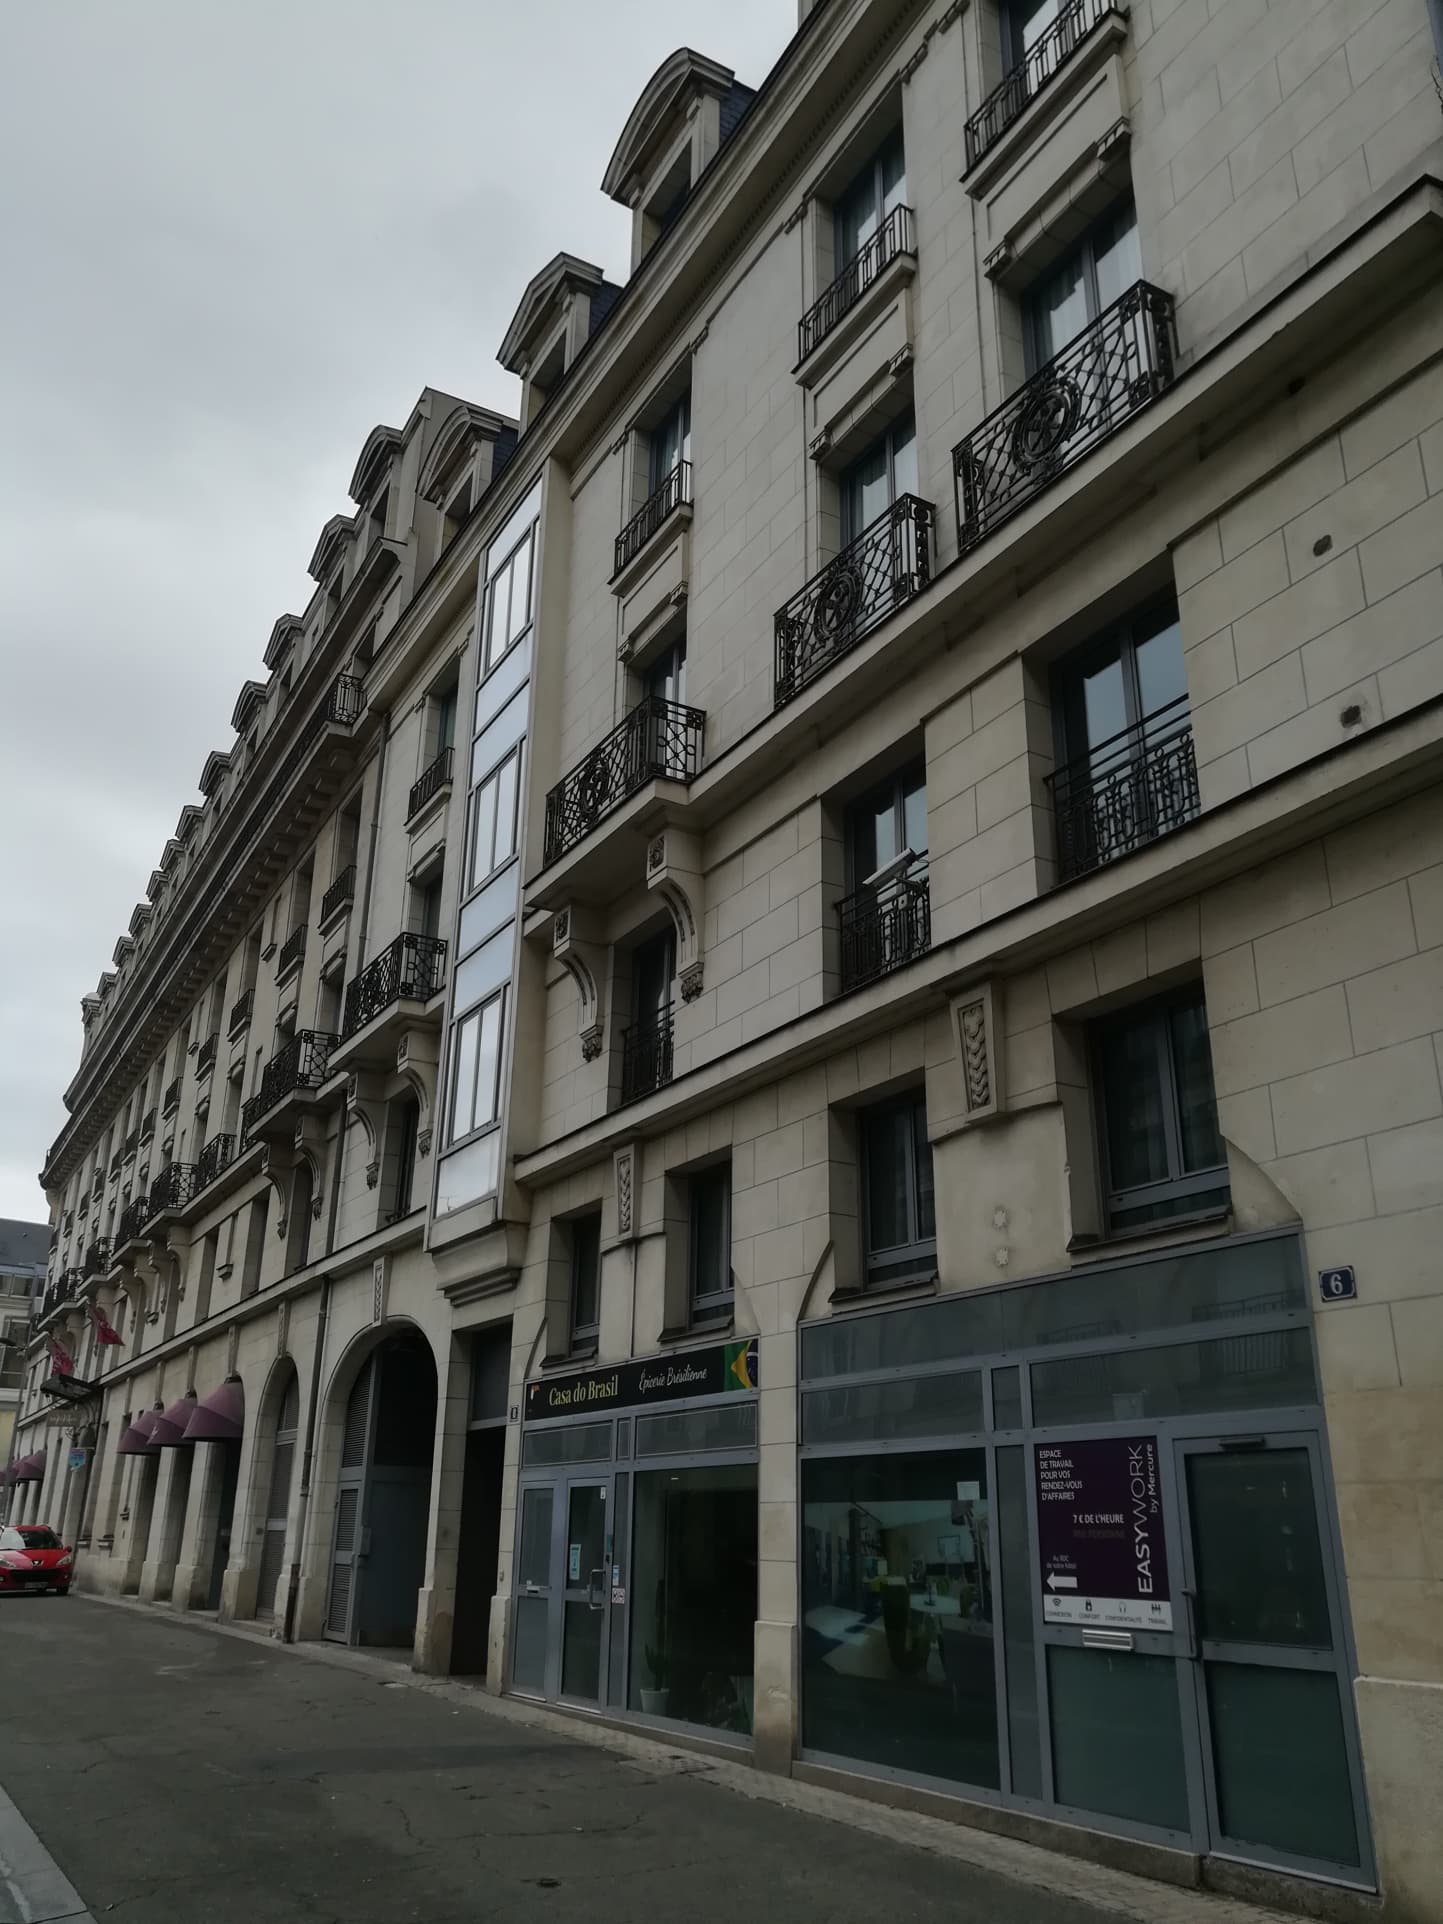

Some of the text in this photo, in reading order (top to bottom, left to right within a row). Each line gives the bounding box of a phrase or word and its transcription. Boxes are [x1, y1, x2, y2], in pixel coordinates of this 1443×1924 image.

[1330, 1273, 1343, 1294] 6
[549, 1374, 620, 1407] Casa do Brasil
[1039, 1449, 1062, 1459] ESPACE
[1040, 1459, 1074, 1469] DE TRAVAIL
[1040, 1470, 1071, 1480] POUR VOS
[1147, 1443, 1160, 1513] by Mercure
[1041, 1480, 1083, 1490] RENDEZ-VOUS
[1041, 1491, 1075, 1501] D'AFFAIRES
[1072, 1514, 1077, 1524] 7
[1084, 1514, 1094, 1524] DE
[1095, 1513, 1125, 1524] L'HEURE
